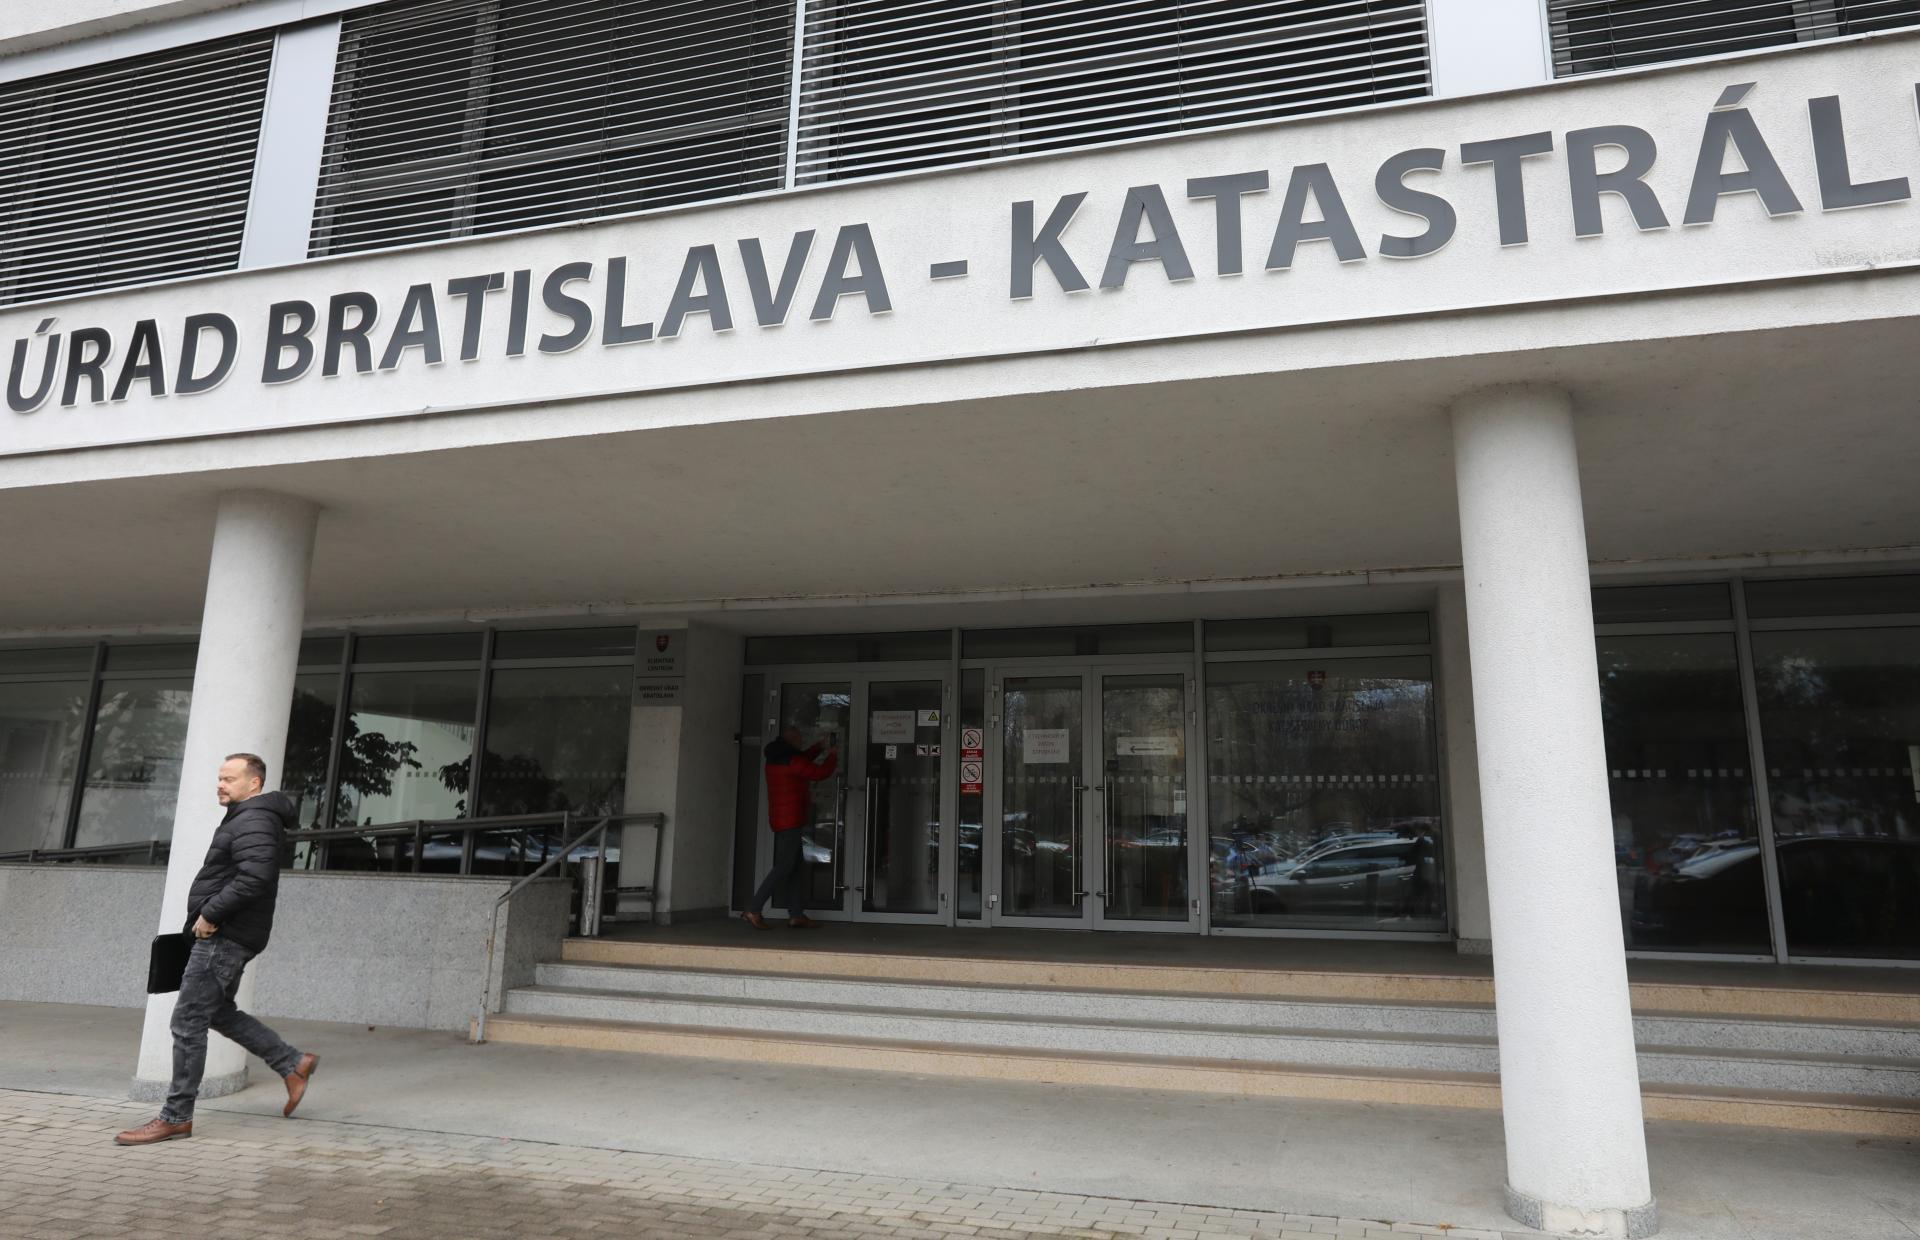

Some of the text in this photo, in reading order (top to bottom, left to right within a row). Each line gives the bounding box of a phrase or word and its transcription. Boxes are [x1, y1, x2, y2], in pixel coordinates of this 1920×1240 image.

[6, 312, 239, 413] ÚRAD
[261, 222, 894, 384] BRATISLAVA
[1009, 82, 1920, 300] KATASTRÁL
